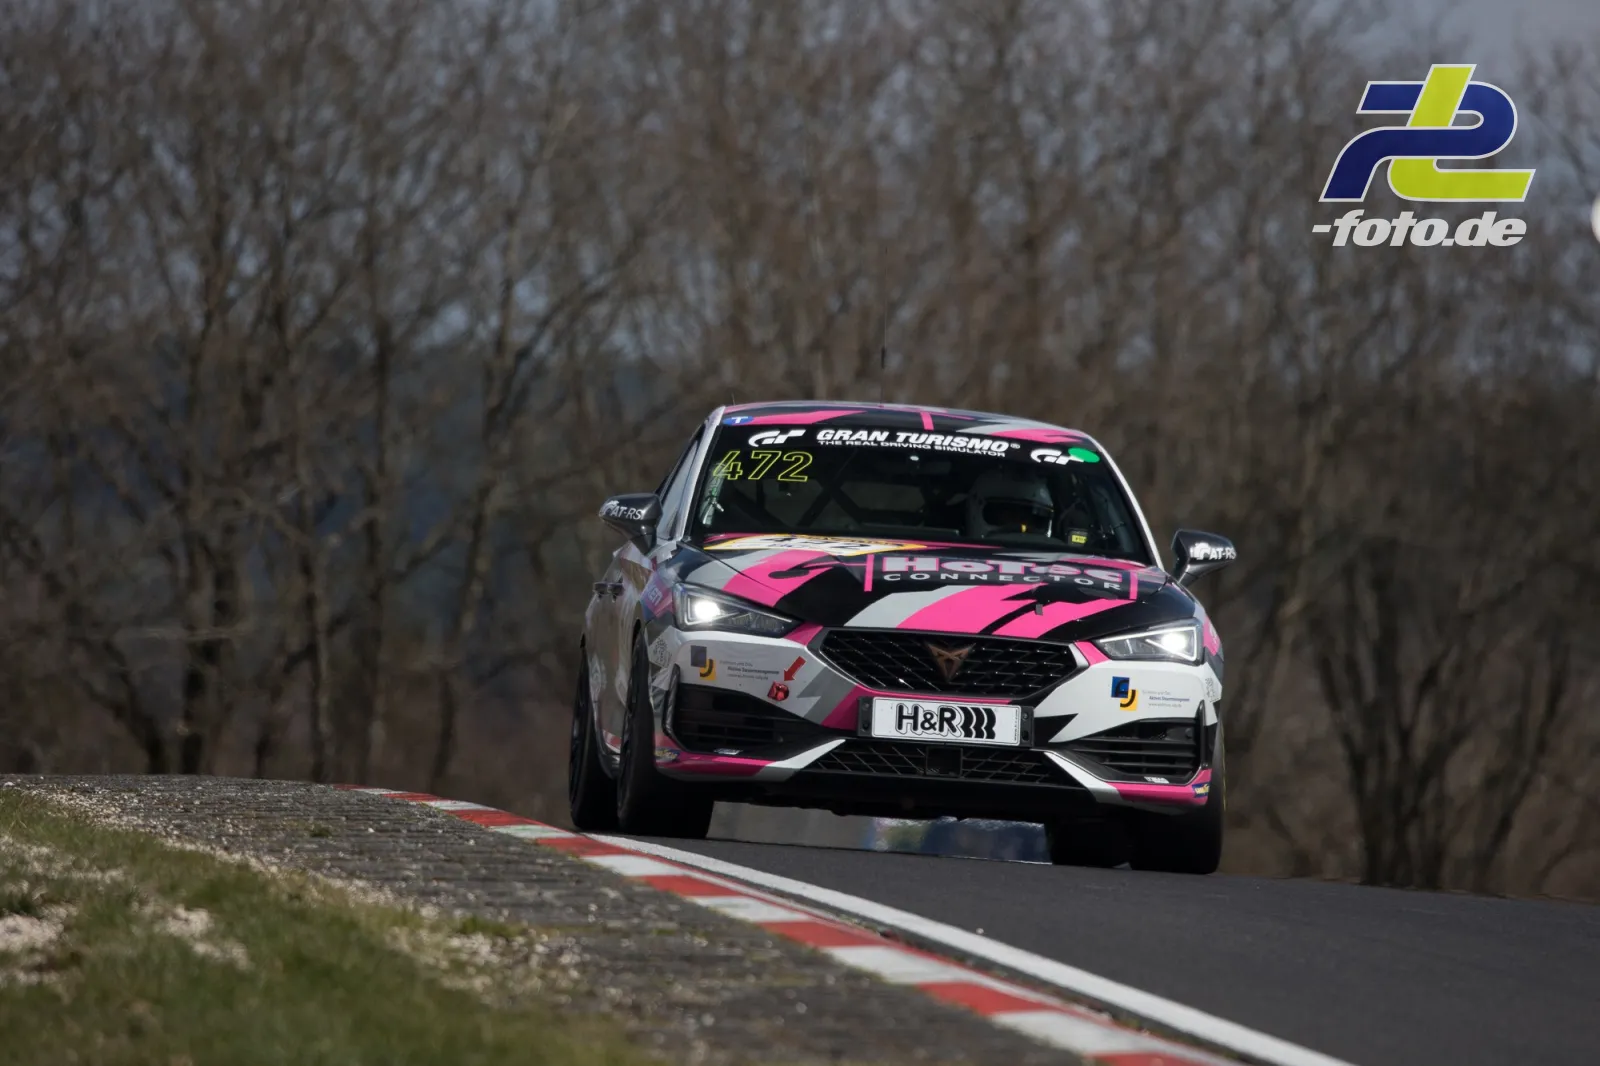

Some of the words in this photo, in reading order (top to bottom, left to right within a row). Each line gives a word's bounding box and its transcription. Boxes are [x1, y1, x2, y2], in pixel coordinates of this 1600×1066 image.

[816, 429, 889, 442] GRAN
[880, 442, 933, 450] DRIVING
[934, 446, 1006, 458] SIMULATOR
[712, 450, 813, 482] 472
[883, 573, 1122, 591] CONNECTOR
[896, 703, 961, 736] H&R
